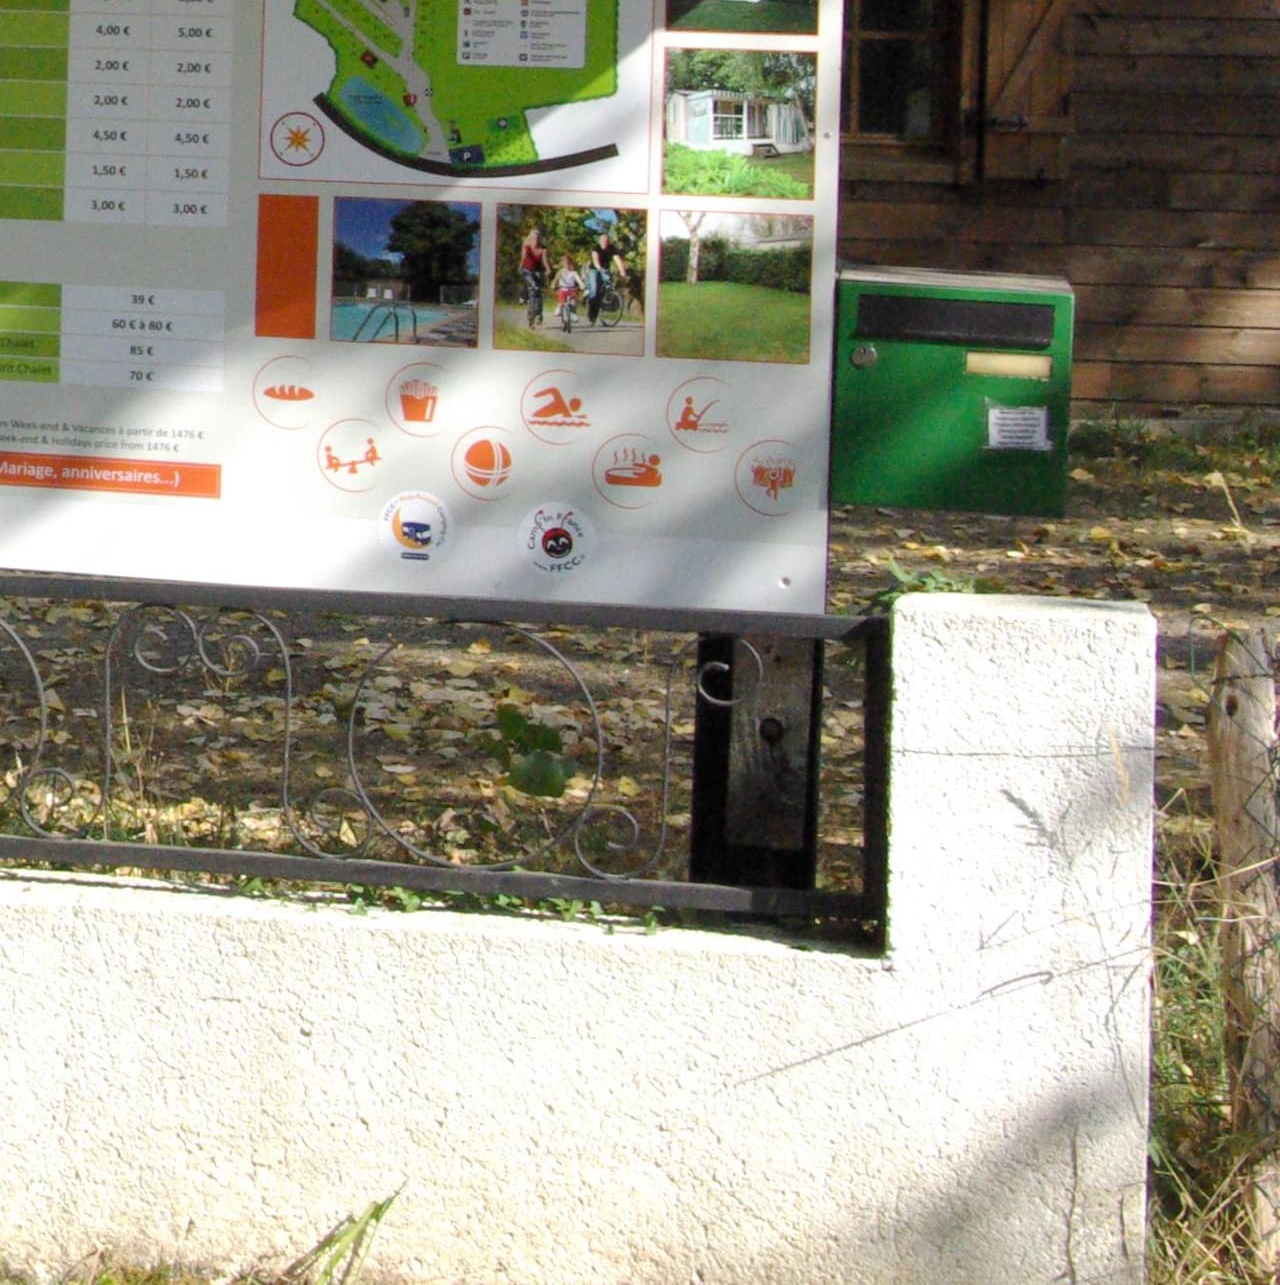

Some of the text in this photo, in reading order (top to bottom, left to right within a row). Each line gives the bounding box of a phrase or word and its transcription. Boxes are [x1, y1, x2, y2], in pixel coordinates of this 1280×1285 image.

[96, 25, 131, 37] 4,00 €
[177, 27, 213, 40] 5,00 €
[95, 60, 130, 72] 2,00 €
[176, 62, 212, 74] 2,00 €
[93, 95, 129, 107] 2,00 €
[175, 97, 211, 109] 2,00 €
[92, 130, 128, 142] 4,50 €
[174, 133, 210, 145] 4,50 €
[92, 165, 127, 177] 1,50 €
[174, 168, 209, 180] 1,50 €
[91, 200, 126, 212] 3,00 €
[173, 203, 208, 215] 3,00 €
[131, 294, 156, 306] 39 €
[112, 318, 126, 330] 60
[148, 320, 163, 331] 80
[0, 336, 36, 349] Chalet
[17, 362, 52, 376] Chalet
[129, 370, 155, 381] 70 €
[126, 425, 155, 438] partir
[156, 427, 169, 438] de
[171, 428, 196, 440] 1476
[197, 429, 205, 440] €
[120, 439, 145, 451] from
[147, 441, 171, 453] 1476
[173, 442, 180, 453] €
[549, 556, 582, 572] FFCC
